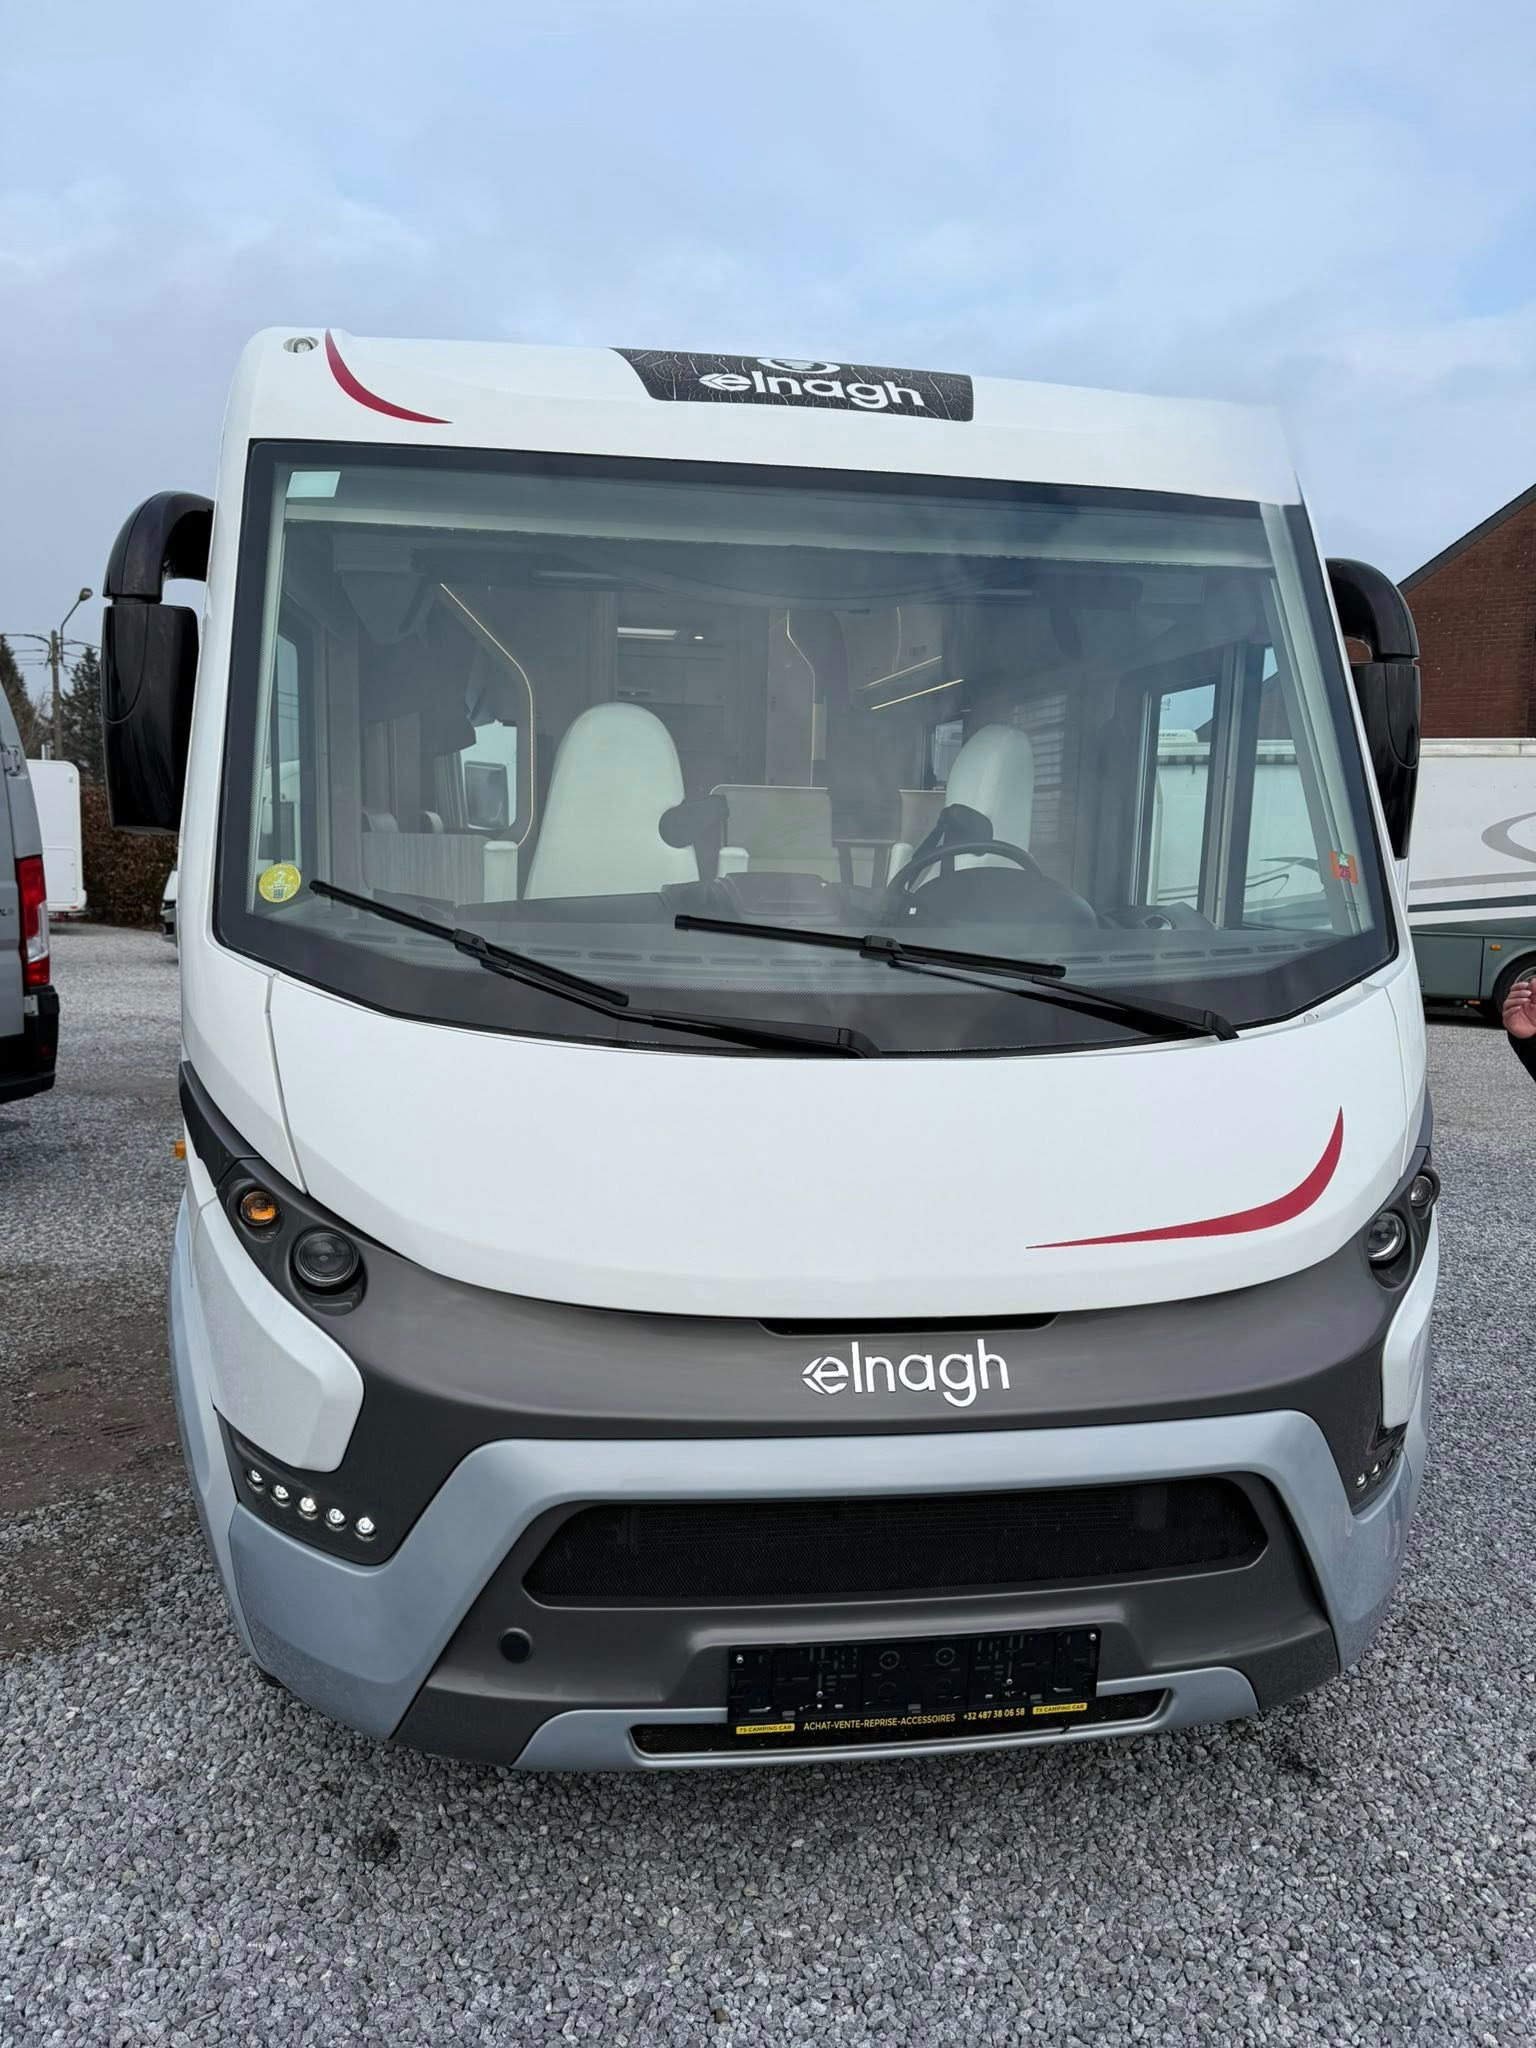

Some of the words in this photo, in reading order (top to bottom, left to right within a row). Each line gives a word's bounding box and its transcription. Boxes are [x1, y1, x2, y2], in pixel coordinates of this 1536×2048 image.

[699, 370, 925, 409] elnagh
[802, 1338, 1010, 1407] elnagh
[748, 1725, 778, 1733] CAMPING
[803, 1713, 956, 1731] ACHAT-VENTE-REPRISE-ACCESSOIRES
[963, 1711, 977, 1720] +32
[978, 1710, 992, 1719] 487
[993, 1709, 1003, 1718] 38
[1004, 1708, 1015, 1717] 06
[1015, 1707, 1025, 1716] 58
